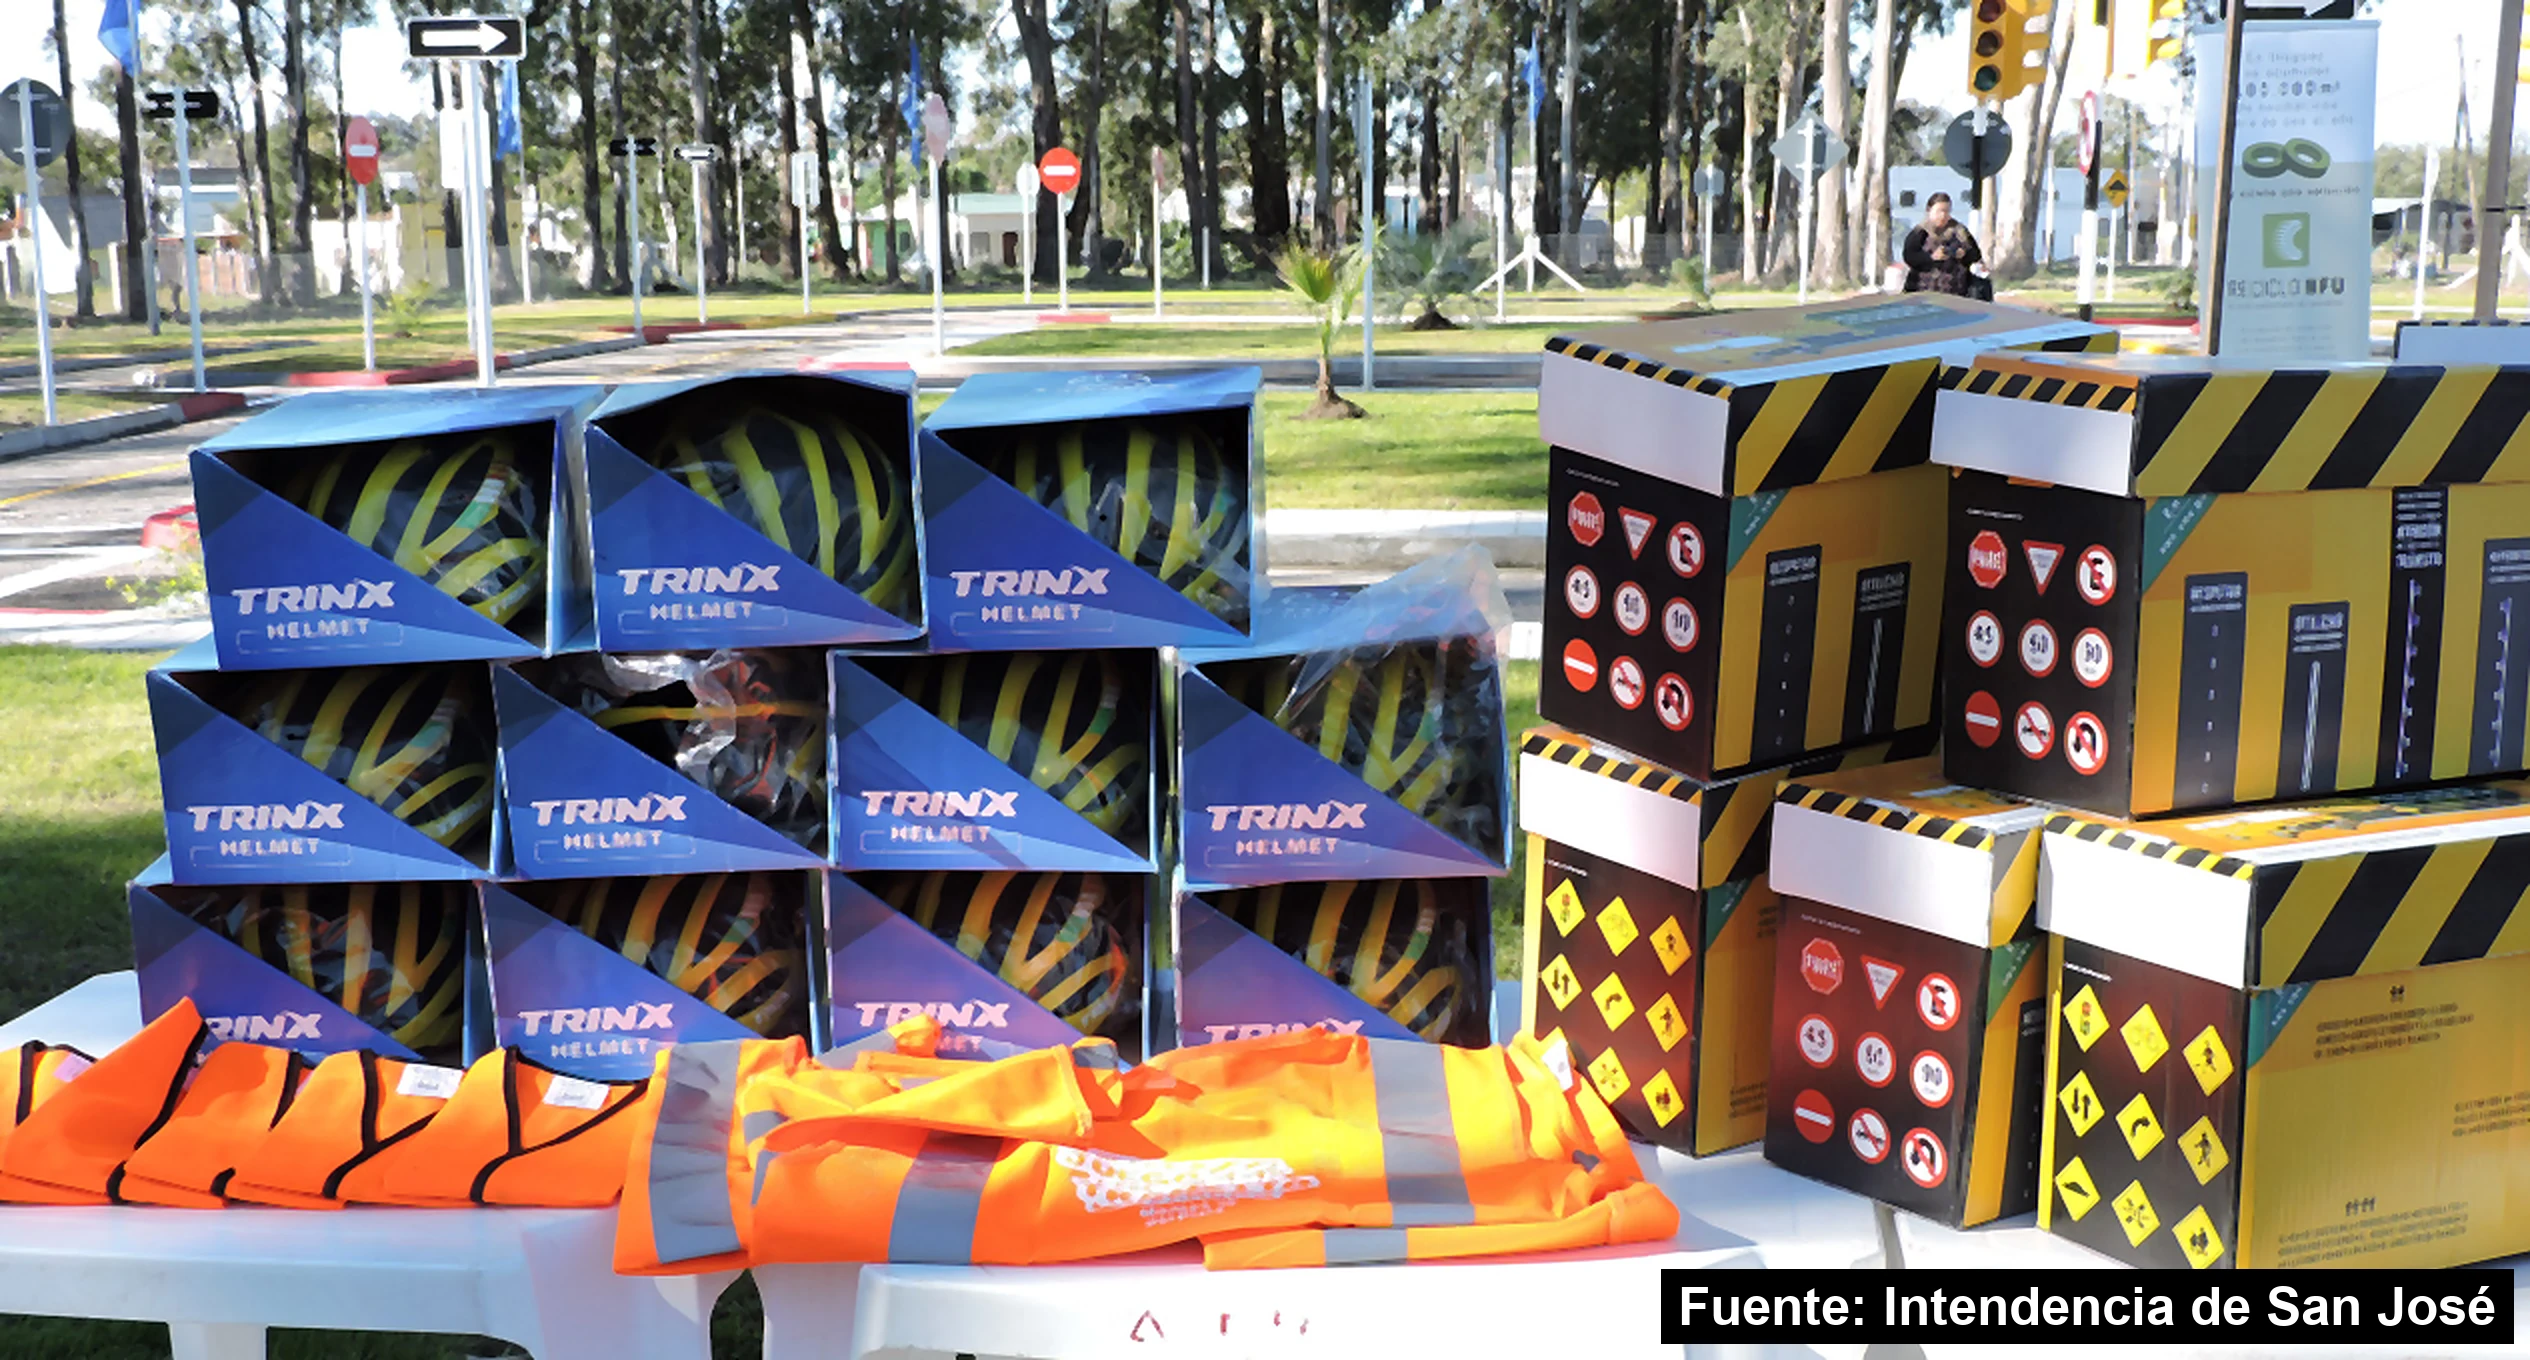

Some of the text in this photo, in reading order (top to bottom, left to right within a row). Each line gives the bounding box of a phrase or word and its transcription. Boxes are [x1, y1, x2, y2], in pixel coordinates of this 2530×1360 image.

[616, 562, 781, 596] TRINX
[949, 565, 1110, 598] TRINX
[231, 578, 396, 615] TRINX
[650, 601, 753, 621] HELMET
[981, 603, 1083, 623] HELMET
[266, 617, 371, 640] HELMET
[186, 800, 344, 832] TRINX
[530, 791, 687, 826] TRINX
[861, 788, 1019, 817] TRINX
[1206, 800, 1368, 831] TRINX
[219, 837, 319, 857] HELMET
[563, 830, 664, 850] HELMET
[890, 825, 991, 843] HELMET
[1235, 837, 1338, 856] HELMET
[205, 1011, 322, 1041] RINX
[518, 1001, 674, 1036] TRINX
[551, 1037, 650, 1059] HELMET
